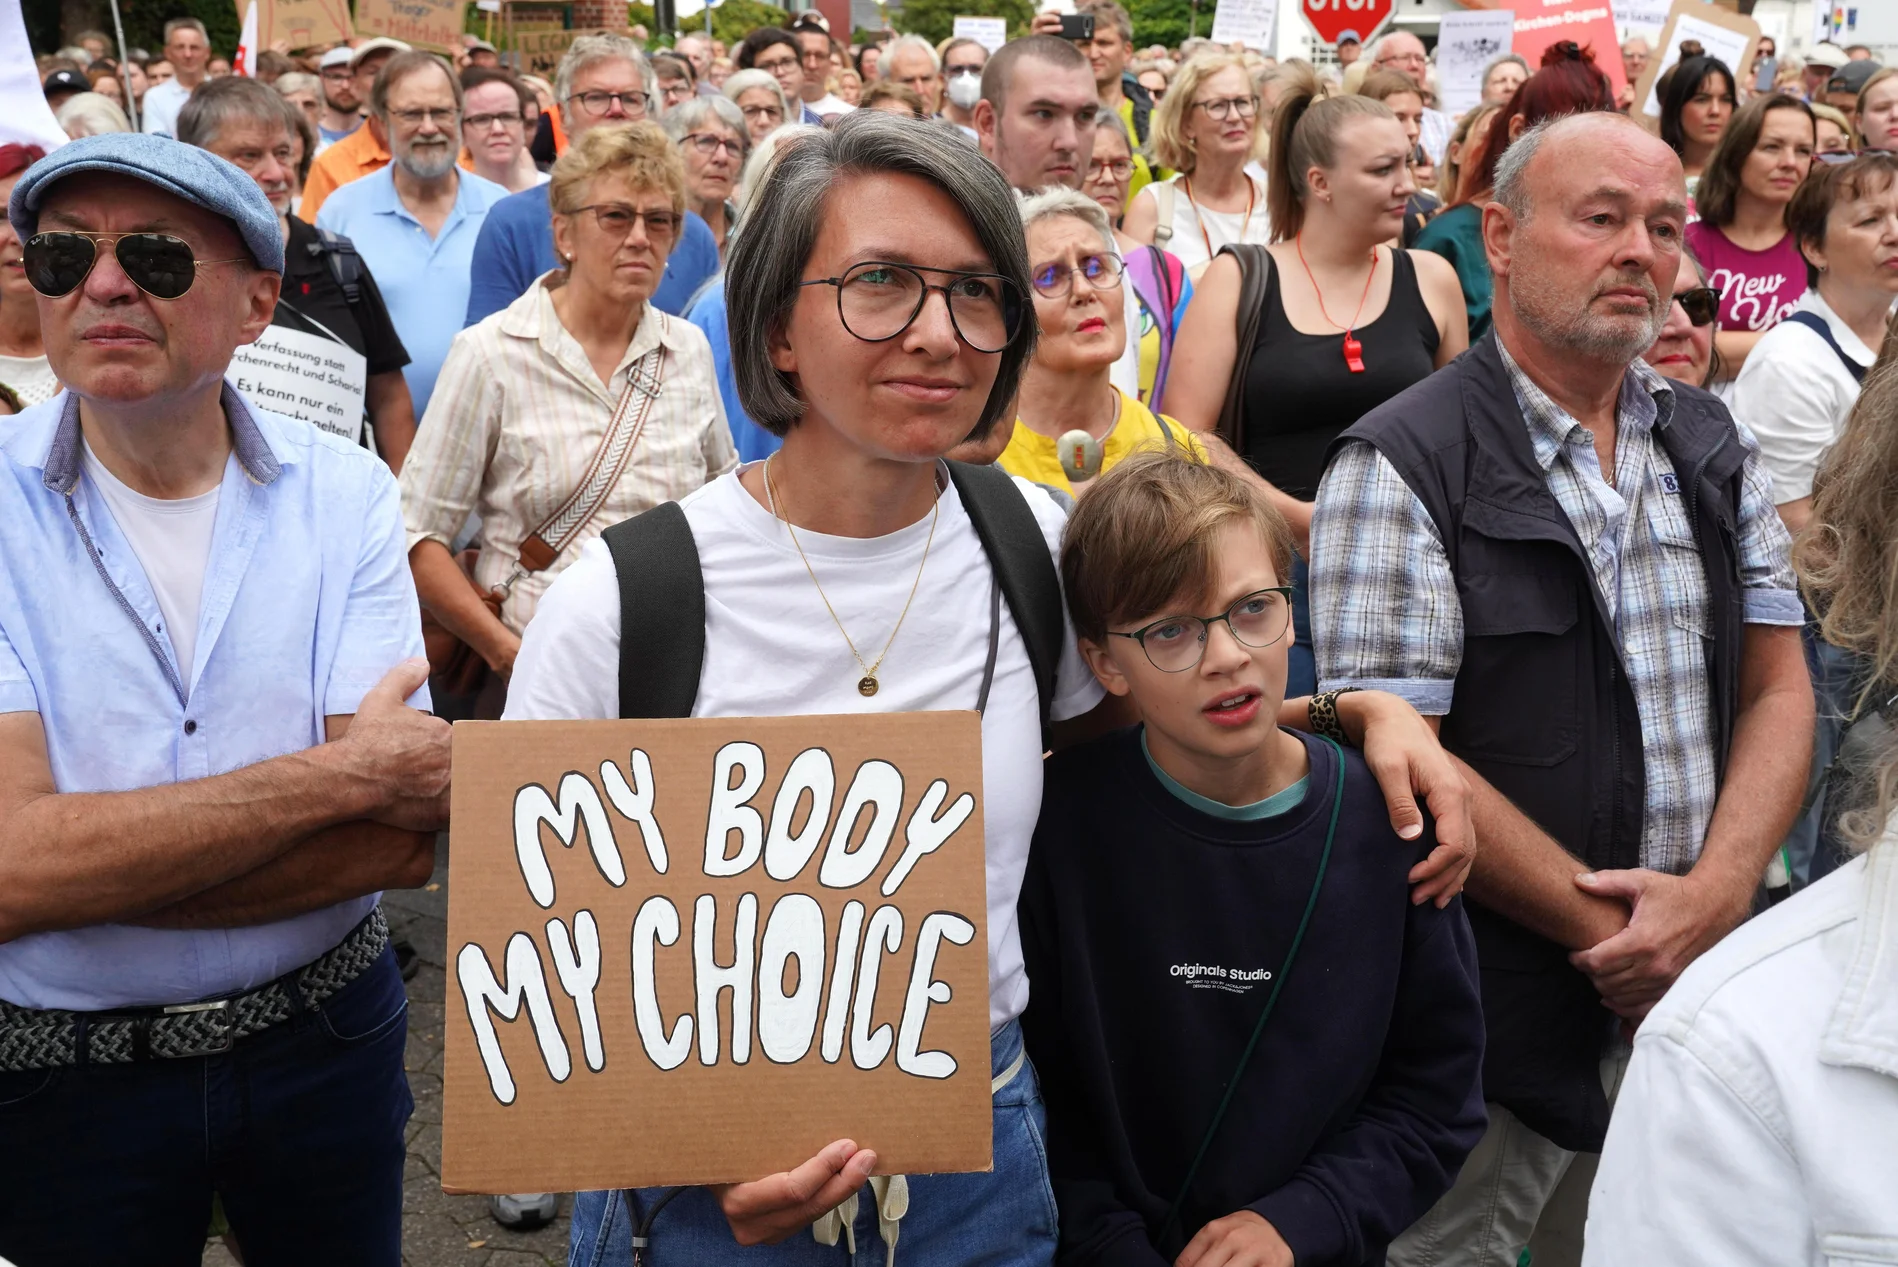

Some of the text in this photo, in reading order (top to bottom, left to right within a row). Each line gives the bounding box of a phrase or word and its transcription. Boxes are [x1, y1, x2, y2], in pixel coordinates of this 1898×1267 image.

[1708, 269, 1787, 302] New
[1730, 295, 1798, 331] Yo
[303, 369, 325, 382] und
[237, 378, 252, 392] Es
[257, 382, 296, 402] kann
[300, 396, 324, 409] nur
[327, 402, 344, 416] ein
[513, 741, 975, 909] MY BODY
[1170, 963, 1272, 981] Originals Studio
[457, 892, 975, 1106] MY CHOICE
